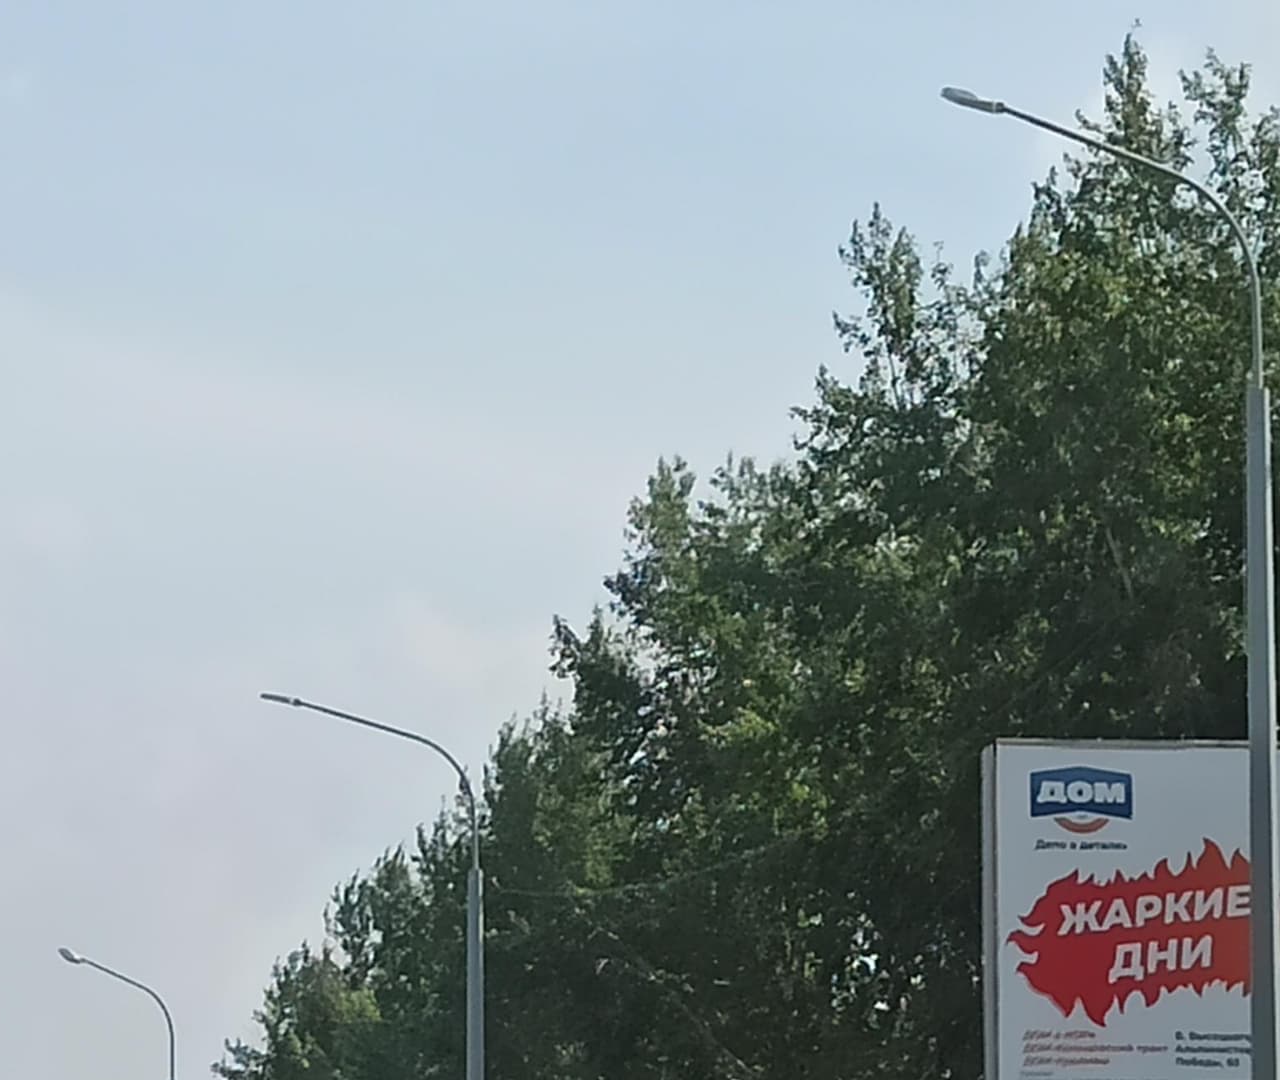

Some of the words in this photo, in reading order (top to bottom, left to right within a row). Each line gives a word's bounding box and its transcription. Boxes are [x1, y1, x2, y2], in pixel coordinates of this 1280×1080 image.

[1036, 780, 1126, 804] ДОМ
[1056, 884, 1252, 936] ЖАРКИЕ
[1108, 935, 1213, 984] ДНИ
